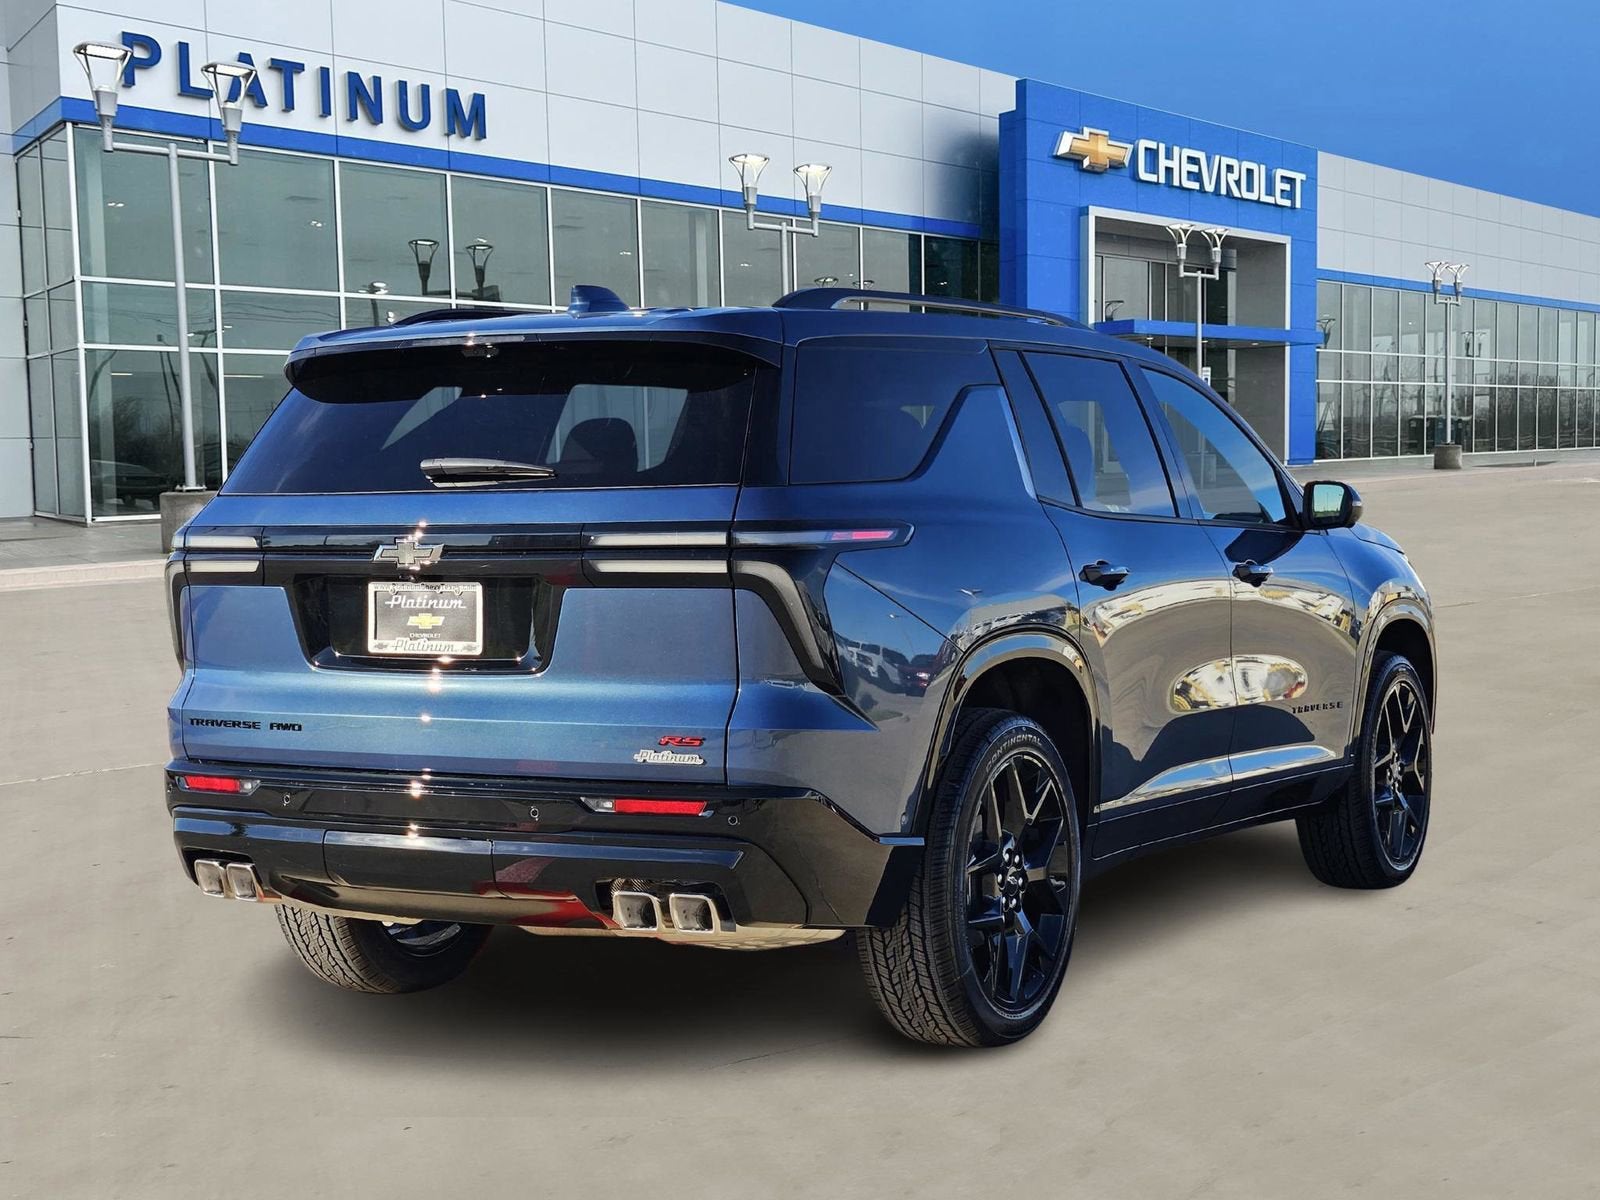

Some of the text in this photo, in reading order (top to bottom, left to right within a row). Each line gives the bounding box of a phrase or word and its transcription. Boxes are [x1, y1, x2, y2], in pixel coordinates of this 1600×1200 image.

[120, 31, 487, 141] PLATINUM
[1137, 138, 1306, 209] CHEVROLET
[385, 595, 467, 609] Platinum
[391, 639, 456, 652] Platinum
[1292, 702, 1344, 714] TRAVERSE
[190, 718, 302, 731] TRAVERSE AWD
[658, 735, 704, 747] RS
[633, 750, 704, 764] Platinum
[985, 734, 1042, 773] CONTINENTAL
